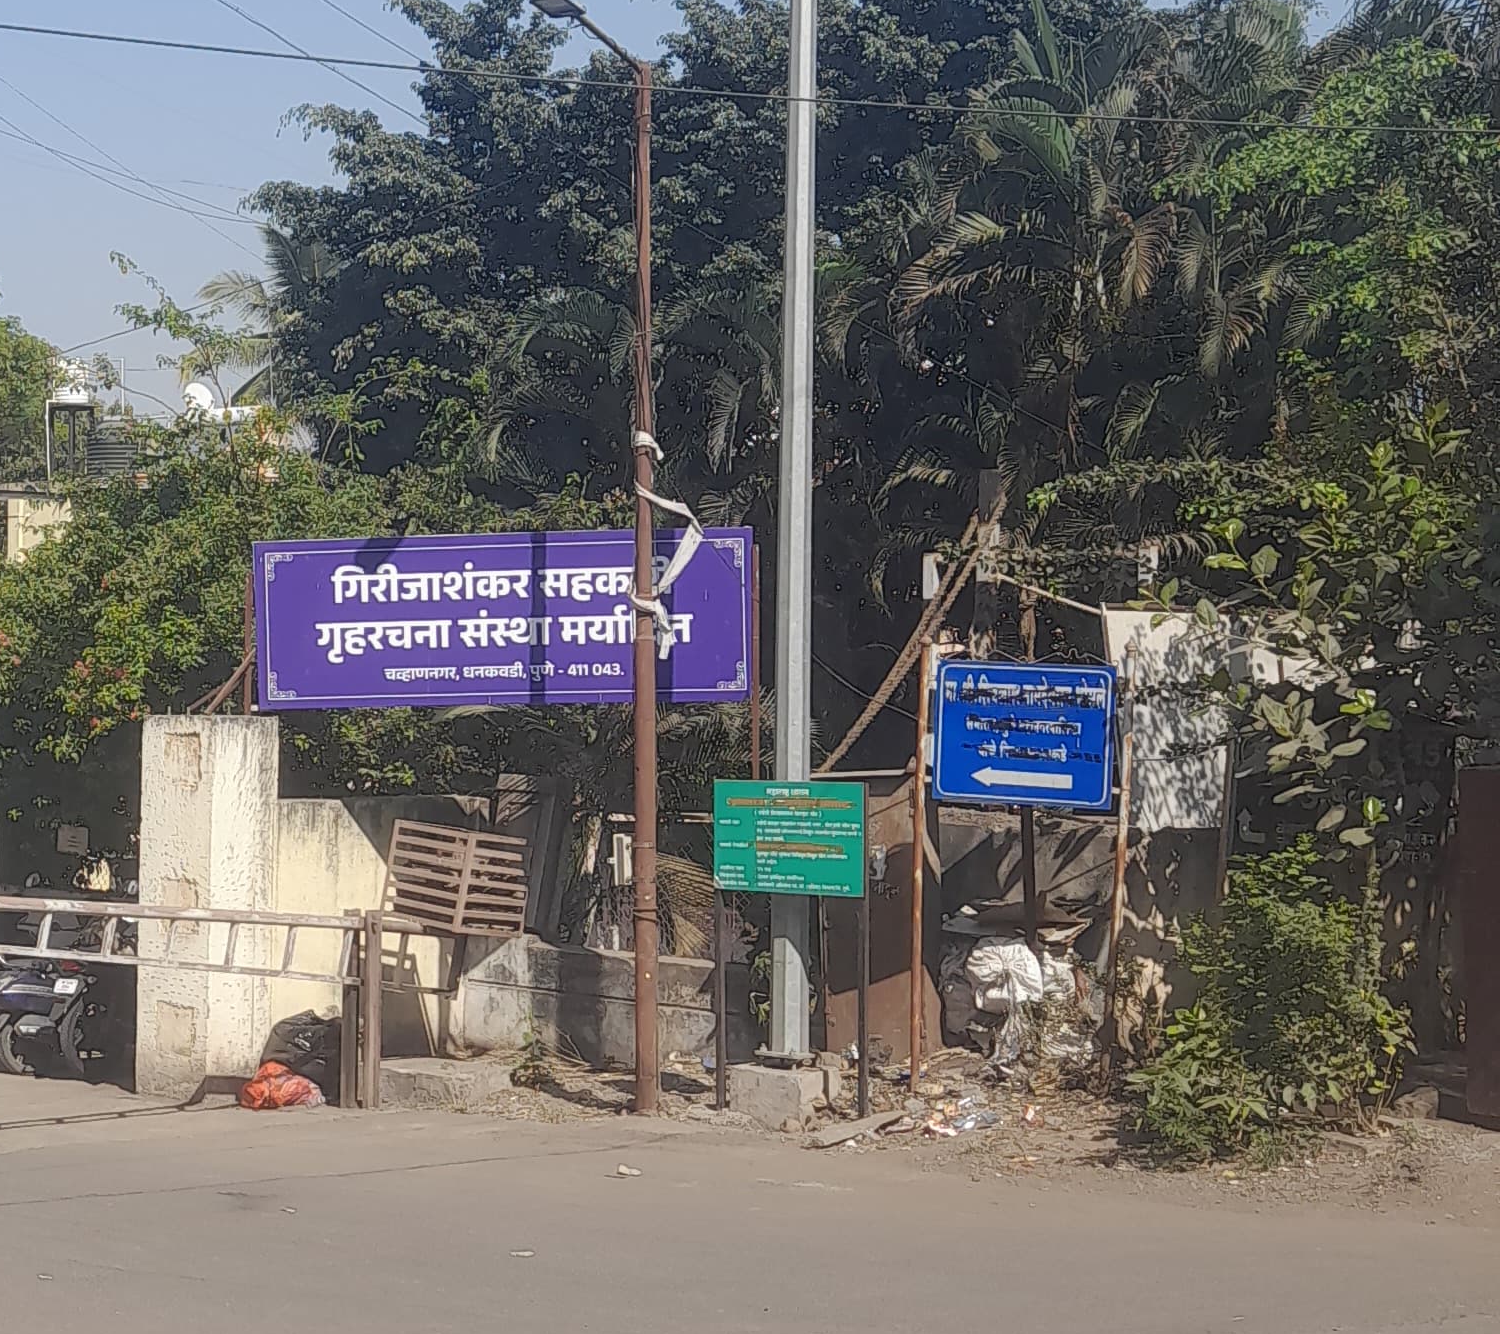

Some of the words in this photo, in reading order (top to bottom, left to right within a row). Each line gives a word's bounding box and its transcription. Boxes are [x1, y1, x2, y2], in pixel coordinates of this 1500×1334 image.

[331, 561, 531, 604] गिरीजाशंकर
[315, 619, 452, 664] गृहरचना
[457, 609, 552, 648] संस्था
[463, 661, 527, 680] धनकवडी,
[529, 661, 555, 681] पुणे
[567, 664, 589, 676] 411
